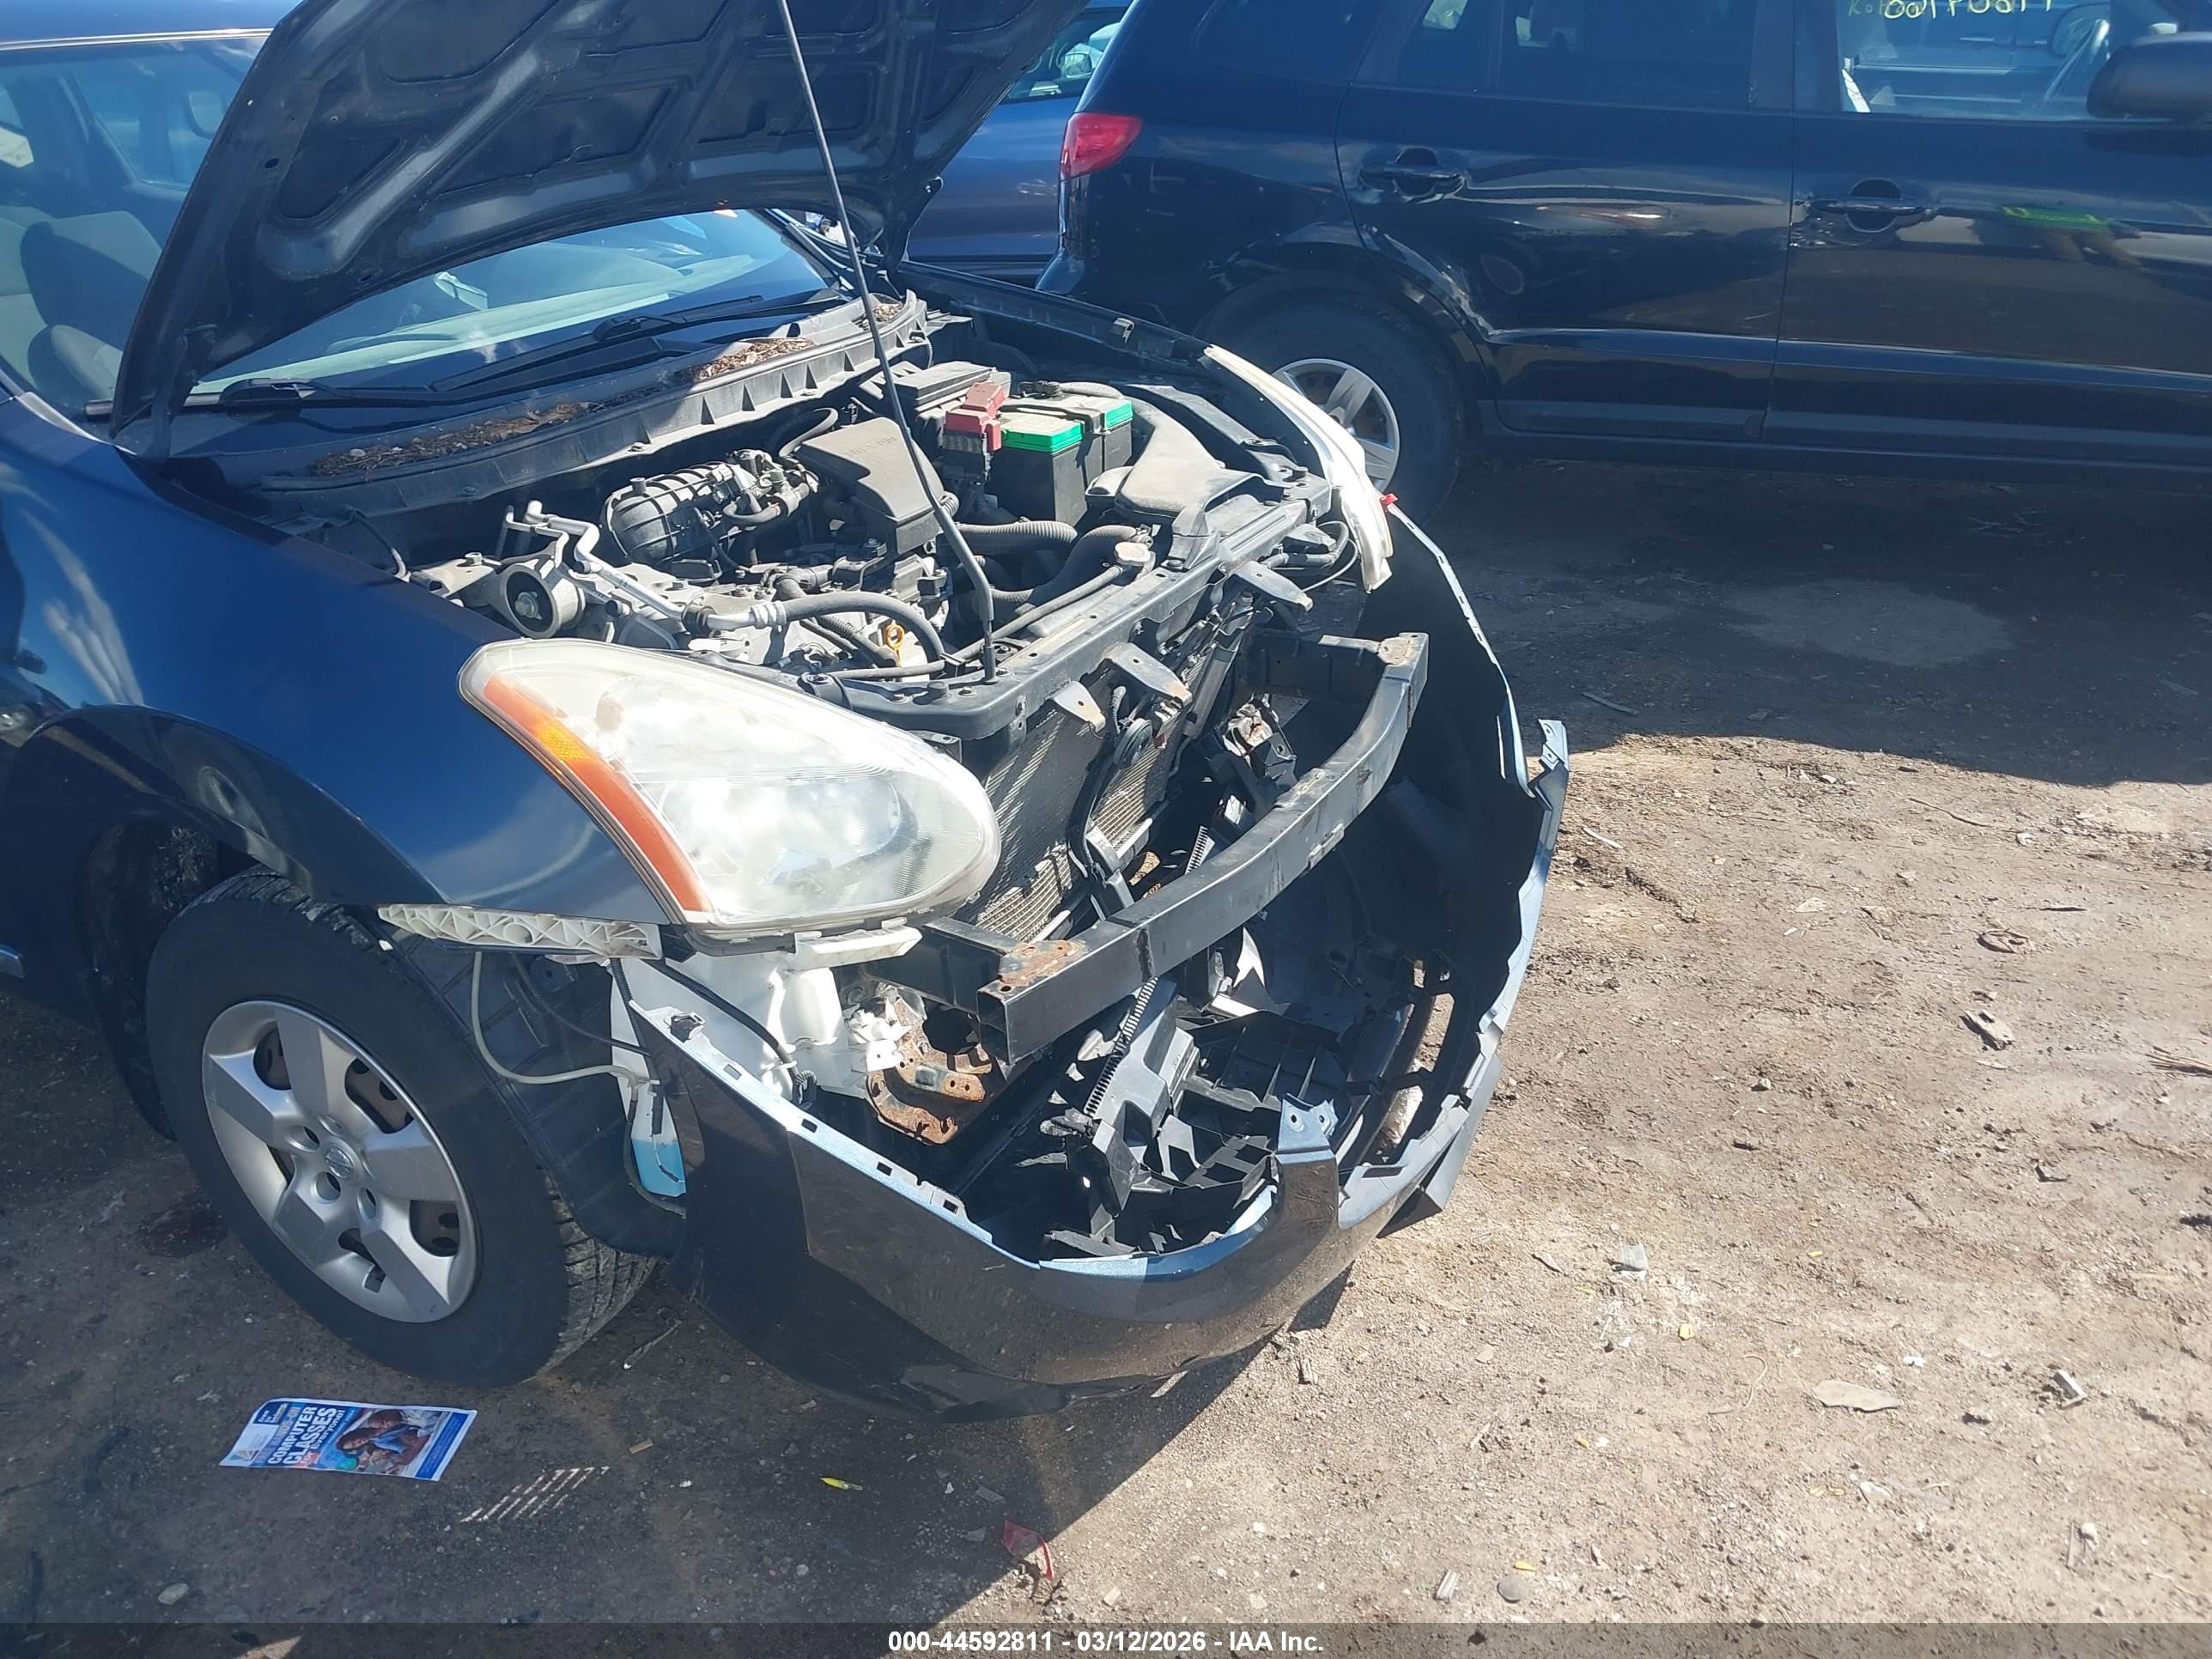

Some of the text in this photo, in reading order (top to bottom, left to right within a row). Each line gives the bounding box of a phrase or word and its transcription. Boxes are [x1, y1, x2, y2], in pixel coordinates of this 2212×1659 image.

[267, 1406, 318, 1465] COMPUTER
[283, 1407, 337, 1465] CLASSES
[310, 1409, 346, 1450] Everyone!
